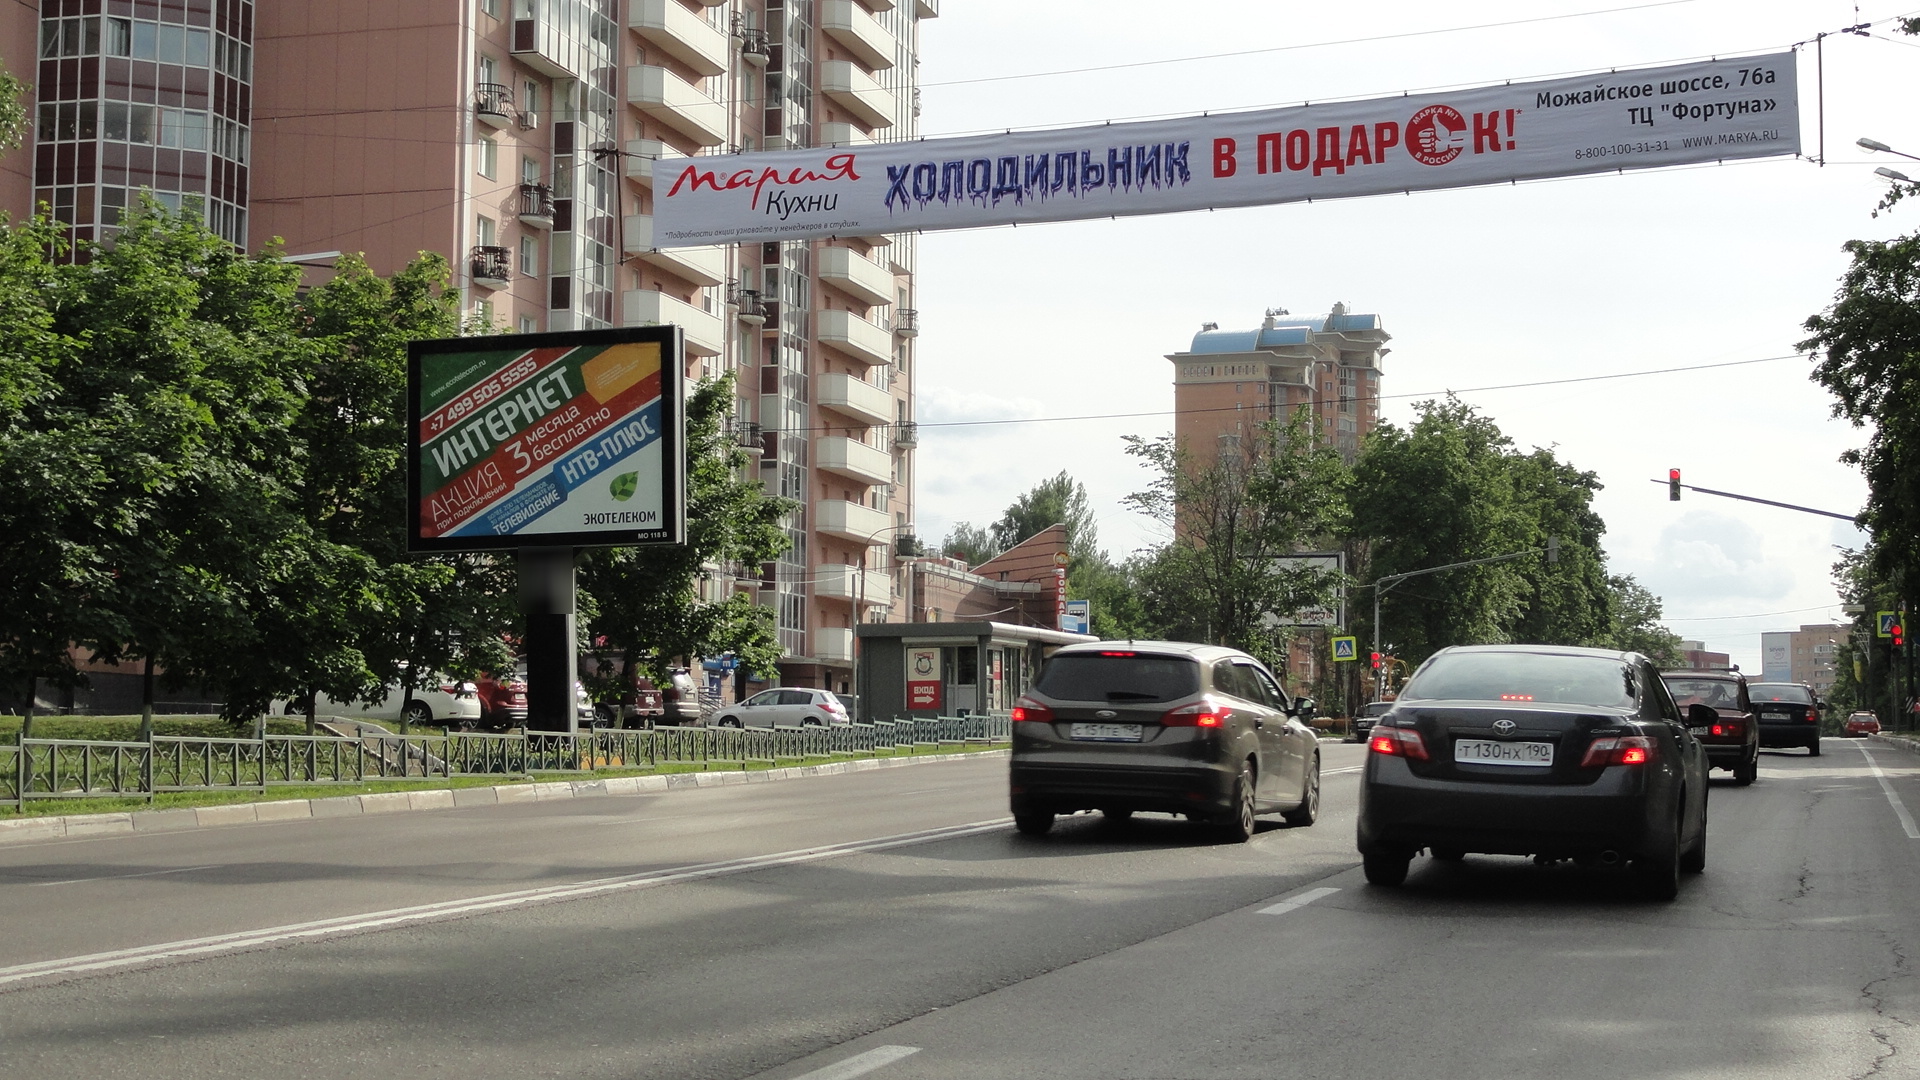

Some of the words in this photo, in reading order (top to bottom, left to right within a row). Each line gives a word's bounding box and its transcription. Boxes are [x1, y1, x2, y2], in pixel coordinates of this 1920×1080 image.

[1536, 83, 1653, 109] Можайское
[1660, 75, 1730, 95] шоссе,
[1738, 68, 1776, 87] 76а
[1412, 107, 1443, 125] МАРКА
[1444, 108, 1459, 120] №1
[1628, 106, 1654, 127] ТЦ
[1661, 98, 1777, 122] "Фортуна»
[1213, 137, 1237, 178] В
[1422, 148, 1459, 164] РОССИИ
[1575, 140, 1669, 160] 8-800-100-31-31
[1682, 129, 1779, 149] WWW.MARYA.RU
[884, 141, 1191, 216] ХОЛОДИЛЬНИК
[765, 190, 838, 221] Кухни
[714, 228, 735, 237] акции
[735, 225, 773, 235] узнавайте
[774, 225, 779, 234] у
[780, 222, 822, 233] менеджеров
[829, 220, 861, 231] студиях.
[430, 359, 487, 398] www.ecotelecom.ru
[431, 414, 444, 431] +7
[447, 397, 474, 421] 499
[472, 379, 501, 404] 505
[500, 357, 537, 387] 5555
[431, 366, 574, 478] ИНТЕРНЕТ
[525, 405, 581, 446] месяца
[533, 407, 611, 461] бесплатно
[504, 440, 531, 475] 3
[561, 415, 656, 484] НТВ-ПЛЮС
[431, 461, 502, 522] АКЦИЯ
[436, 517, 453, 531] при
[453, 482, 507, 518] подключении
[492, 489, 561, 535] ТЕЛЕВИДЕНИЕ
[583, 511, 656, 525] ЭКОТЕЛЕКОМ
[914, 686, 935, 694] ВХОД
